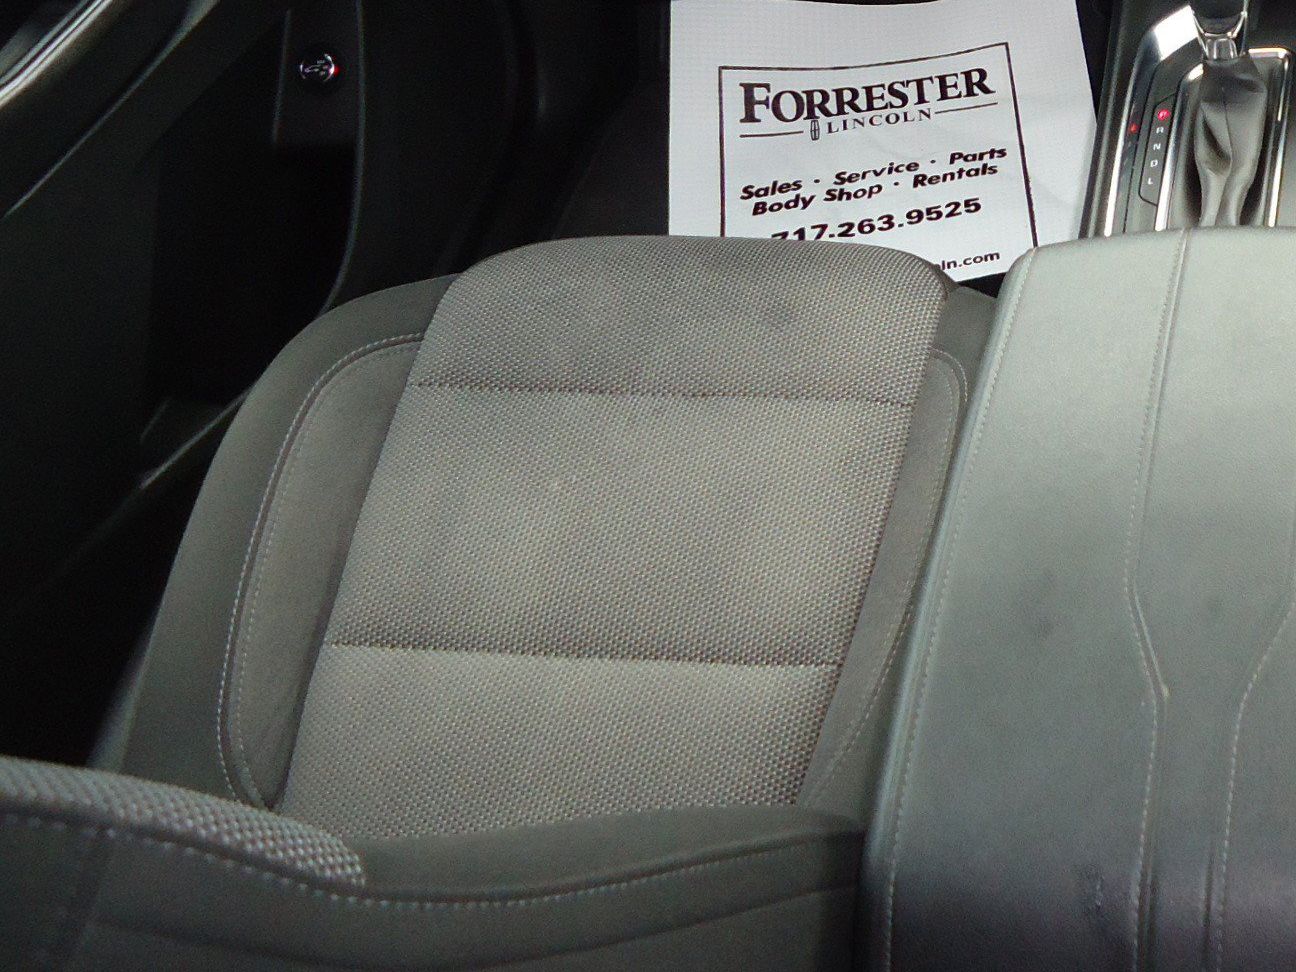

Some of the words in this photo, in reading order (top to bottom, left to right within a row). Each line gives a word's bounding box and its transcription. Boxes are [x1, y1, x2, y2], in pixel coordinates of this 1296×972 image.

[739, 67, 996, 123] FORRESTER
[826, 107, 932, 134] LINCOLN
[1152, 142, 1162, 151] N
[739, 179, 803, 201] Sales
[832, 161, 920, 186] Service
[949, 146, 1008, 165] Parts
[1149, 159, 1159, 168] D
[751, 193, 816, 217] Body
[823, 182, 884, 203] Shop
[912, 162, 999, 189] Rentals
[1147, 177, 1154, 185] L
[770, 196, 983, 243] 717.263.9525
[938, 250, 1001, 271] ln.com
